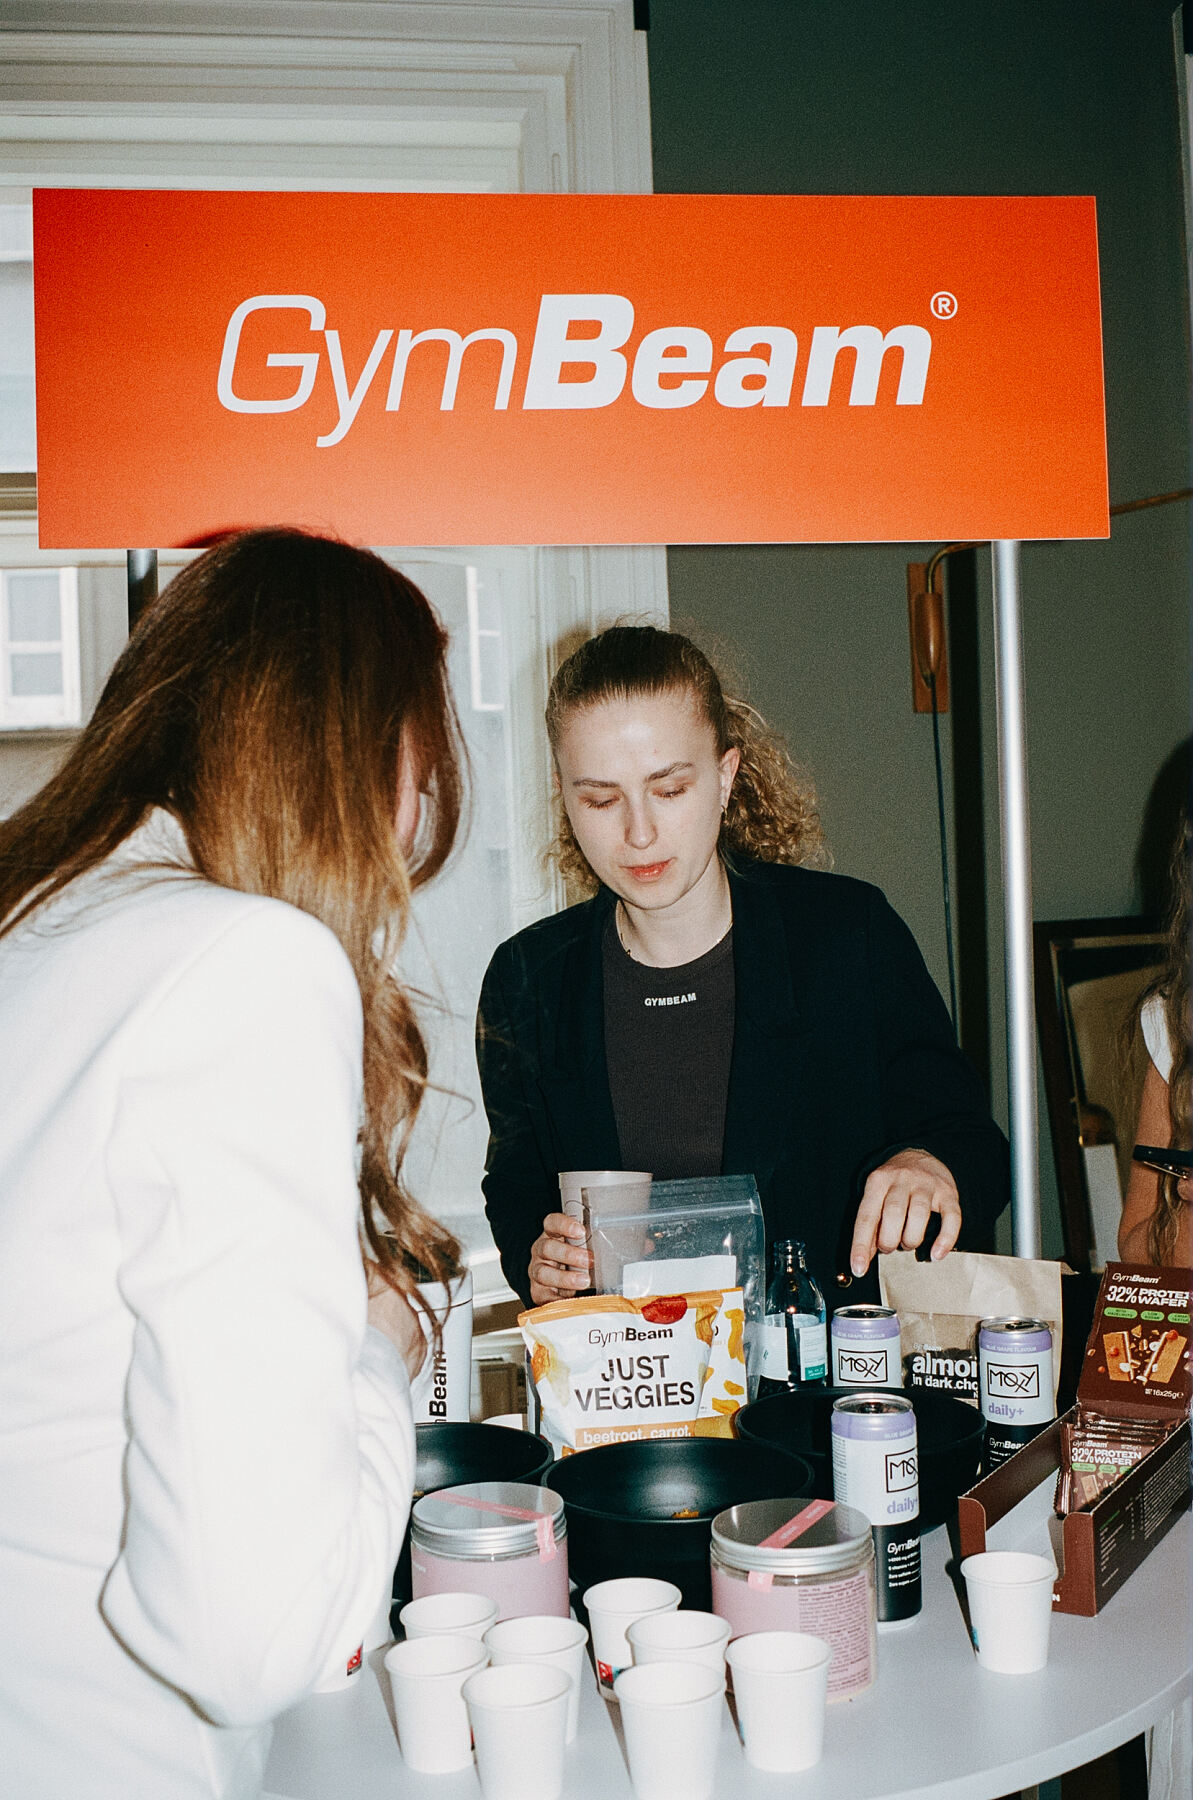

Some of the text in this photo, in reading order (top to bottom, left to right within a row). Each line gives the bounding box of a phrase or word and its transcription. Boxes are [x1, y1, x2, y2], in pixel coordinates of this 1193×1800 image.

[644, 992, 697, 1007] GYMBEAM
[1112, 1272, 1161, 1284] GymBeam
[1106, 1285, 1139, 1304] 32%
[1138, 1296, 1188, 1308] WAFER
[588, 1327, 674, 1348] GymBeam
[601, 1355, 670, 1382] JUST
[841, 1355, 885, 1378] MOXY
[912, 1373, 922, 1386] in
[989, 1369, 1036, 1393] MOXY
[574, 1381, 695, 1412] VEGGIES
[988, 1402, 1024, 1419] daily+
[1071, 1447, 1094, 1463] 32%
[1094, 1449, 1142, 1460] PROTEIN
[1094, 1456, 1132, 1466] WAFER
